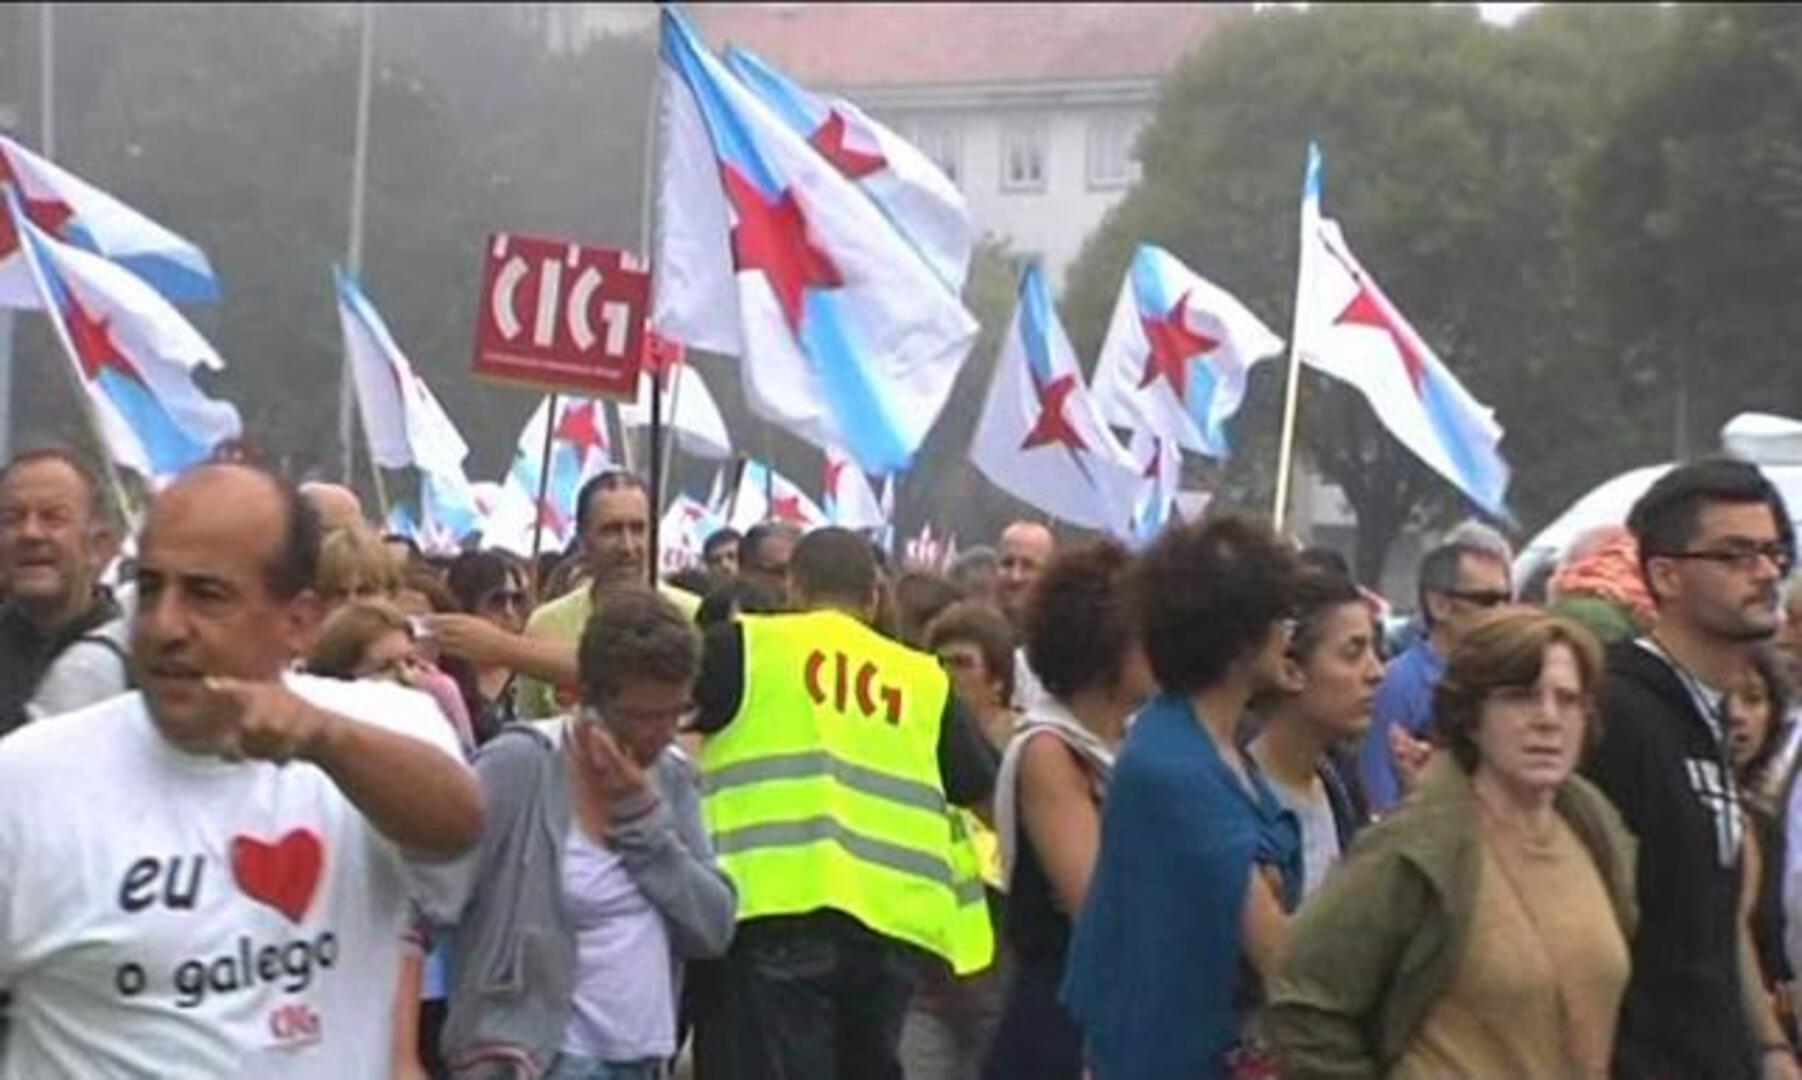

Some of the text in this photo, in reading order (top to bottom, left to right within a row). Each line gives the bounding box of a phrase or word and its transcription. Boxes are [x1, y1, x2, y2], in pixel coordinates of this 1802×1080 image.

[492, 255, 630, 357] CIG
[804, 649, 902, 726] CIG
[118, 854, 205, 912] eu
[115, 931, 338, 1008] o galego
